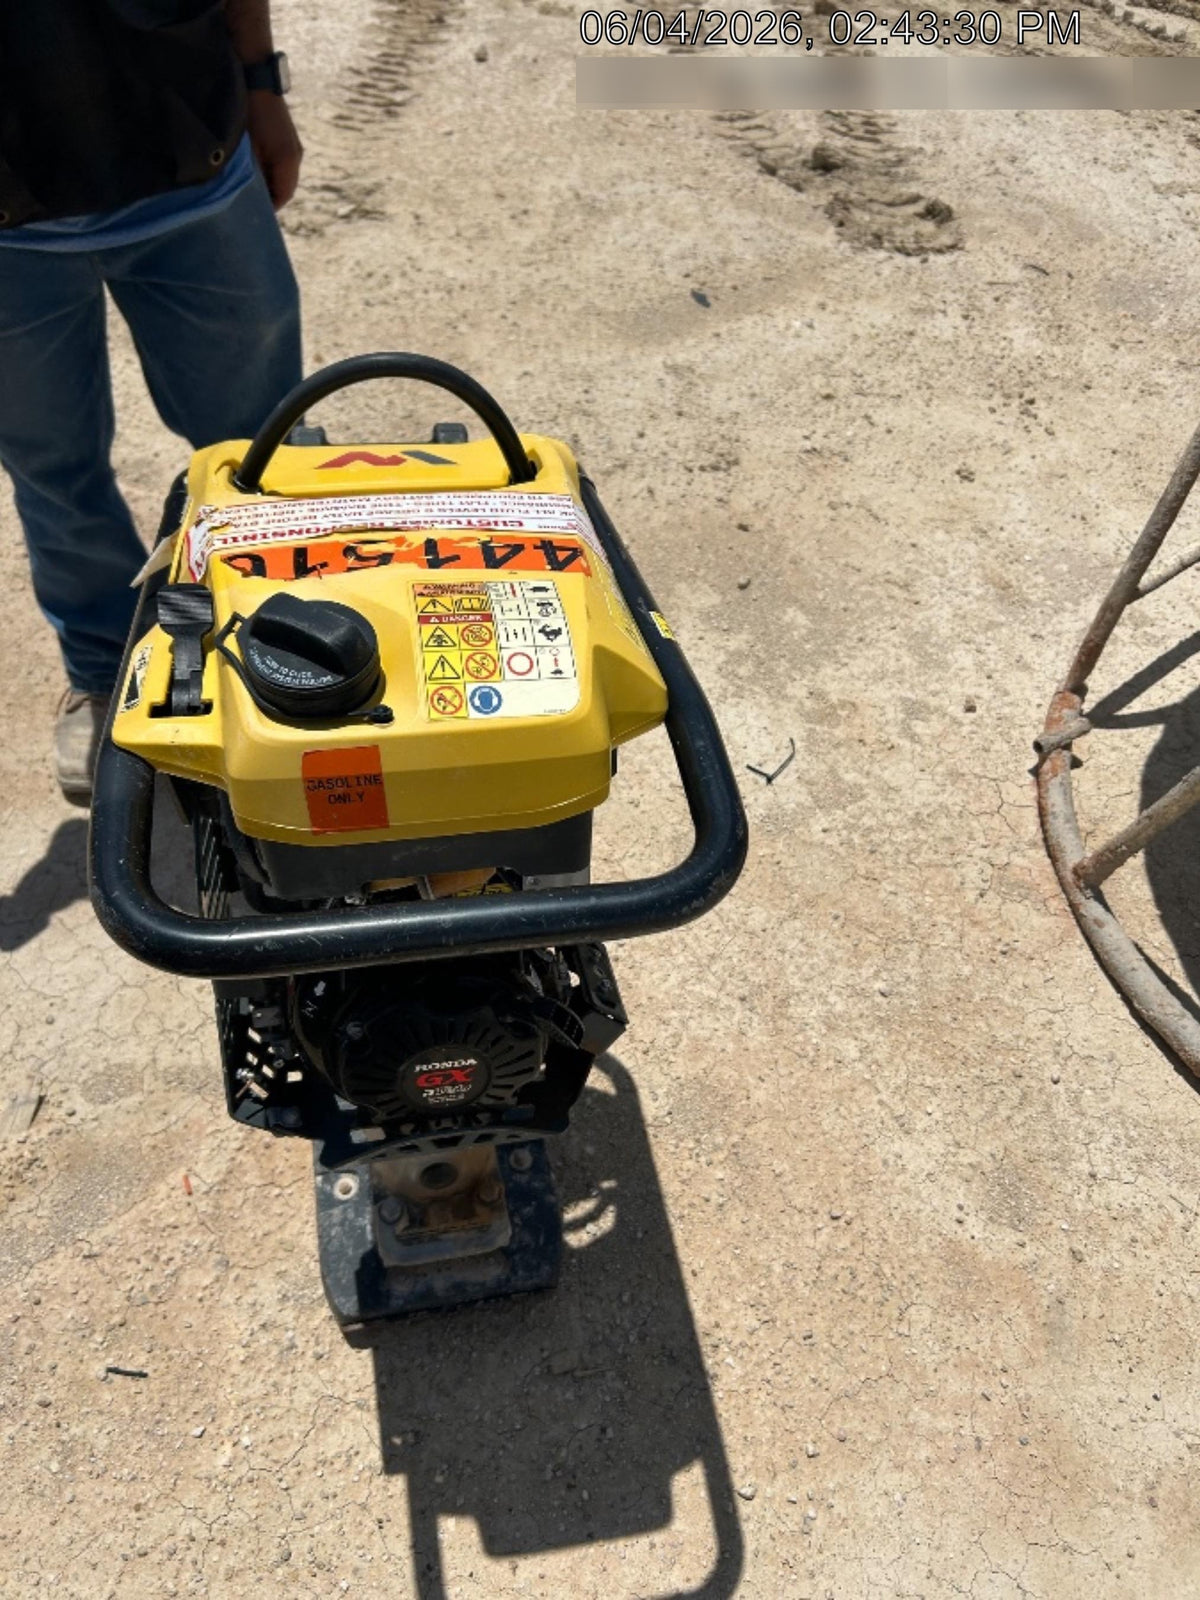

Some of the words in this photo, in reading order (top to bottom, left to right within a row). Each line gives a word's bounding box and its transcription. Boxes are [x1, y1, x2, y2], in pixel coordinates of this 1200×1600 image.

[306, 774, 384, 793] GASOLINE
[327, 791, 365, 805] ONLY
[414, 1059, 477, 1072] HONDA
[416, 1067, 475, 1088] GX
